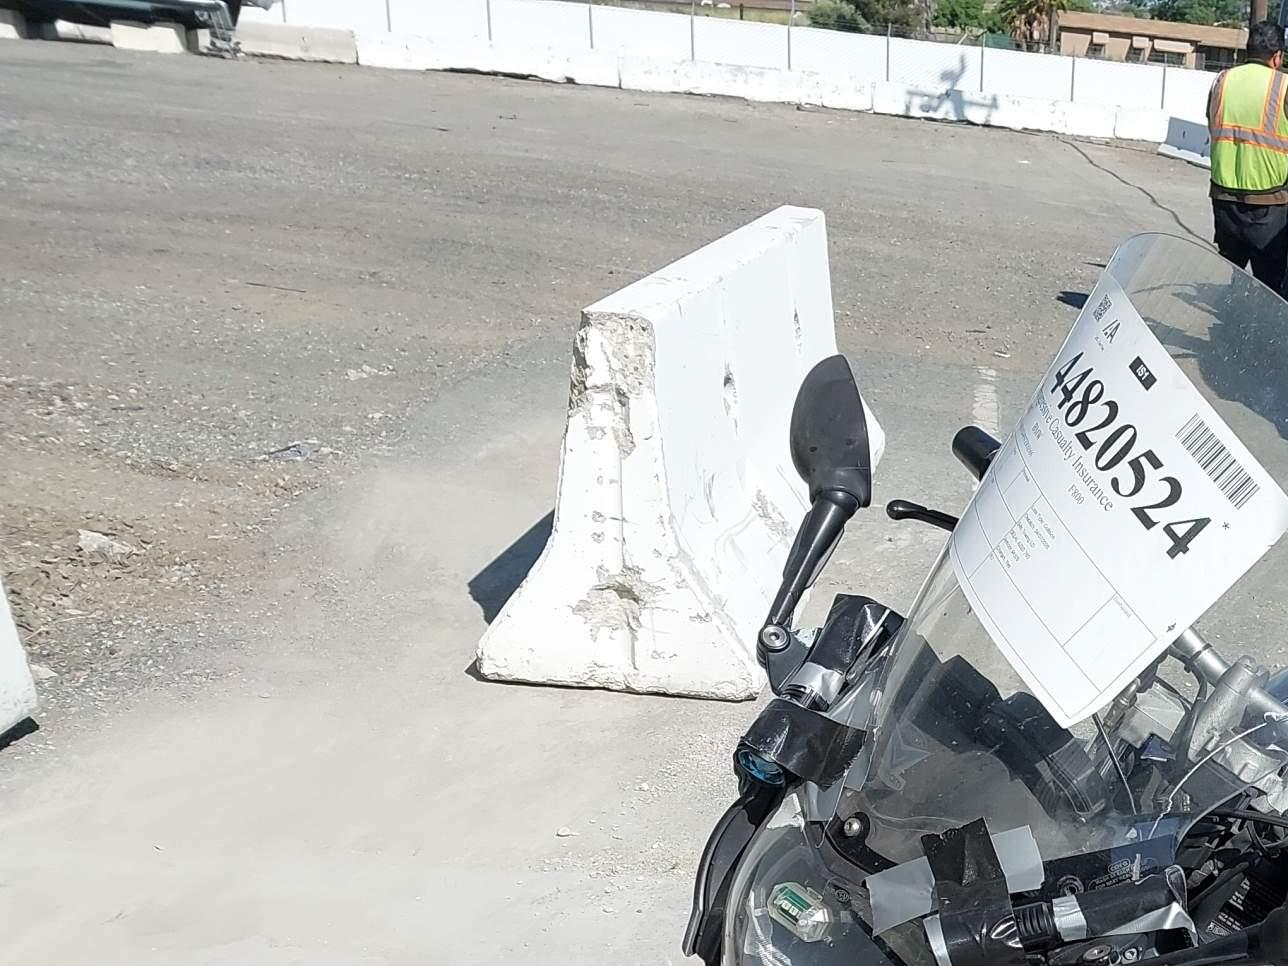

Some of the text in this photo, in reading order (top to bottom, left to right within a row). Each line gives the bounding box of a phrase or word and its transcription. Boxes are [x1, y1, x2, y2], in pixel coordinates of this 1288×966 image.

[1136, 364, 1149, 381] IS1
[1049, 418, 1075, 461] Casualty
[1072, 456, 1113, 511] Insurance
[1051, 351, 1212, 560] 44820524
